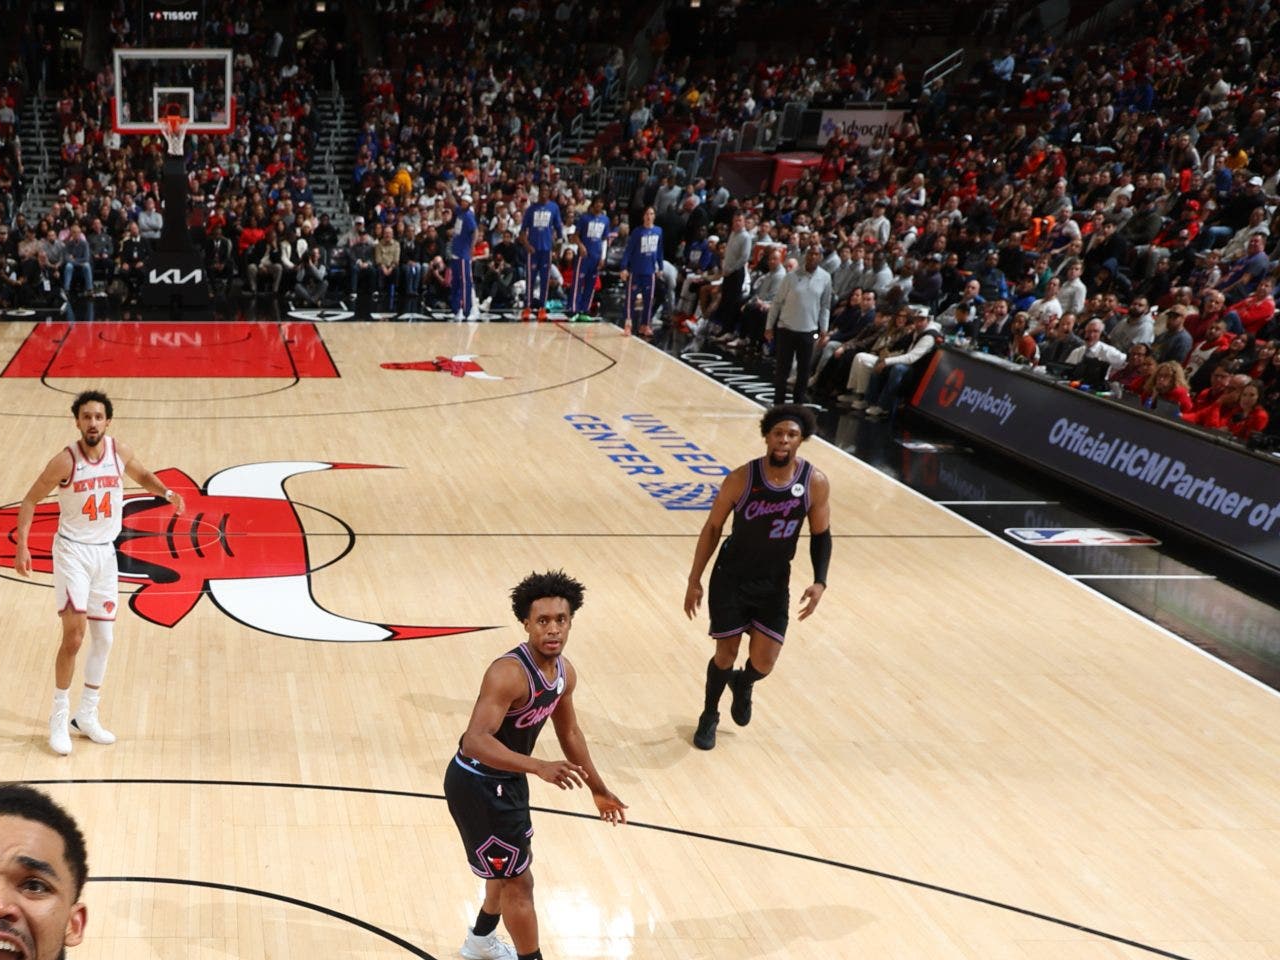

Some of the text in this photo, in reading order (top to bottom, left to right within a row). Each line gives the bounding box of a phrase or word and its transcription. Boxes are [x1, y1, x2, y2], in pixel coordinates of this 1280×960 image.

[162, 11, 198, 21] TISSOT
[149, 269, 202, 284] KIA
[956, 386, 1016, 425] paylocity
[563, 413, 664, 476] CENTER
[621, 413, 731, 477] UNITED
[73, 479, 95, 493] NEW
[1048, 417, 1280, 532] Official HCM Partner of
[81, 491, 112, 521] 44
[744, 498, 801, 520] Chicago
[769, 519, 799, 538] 28
